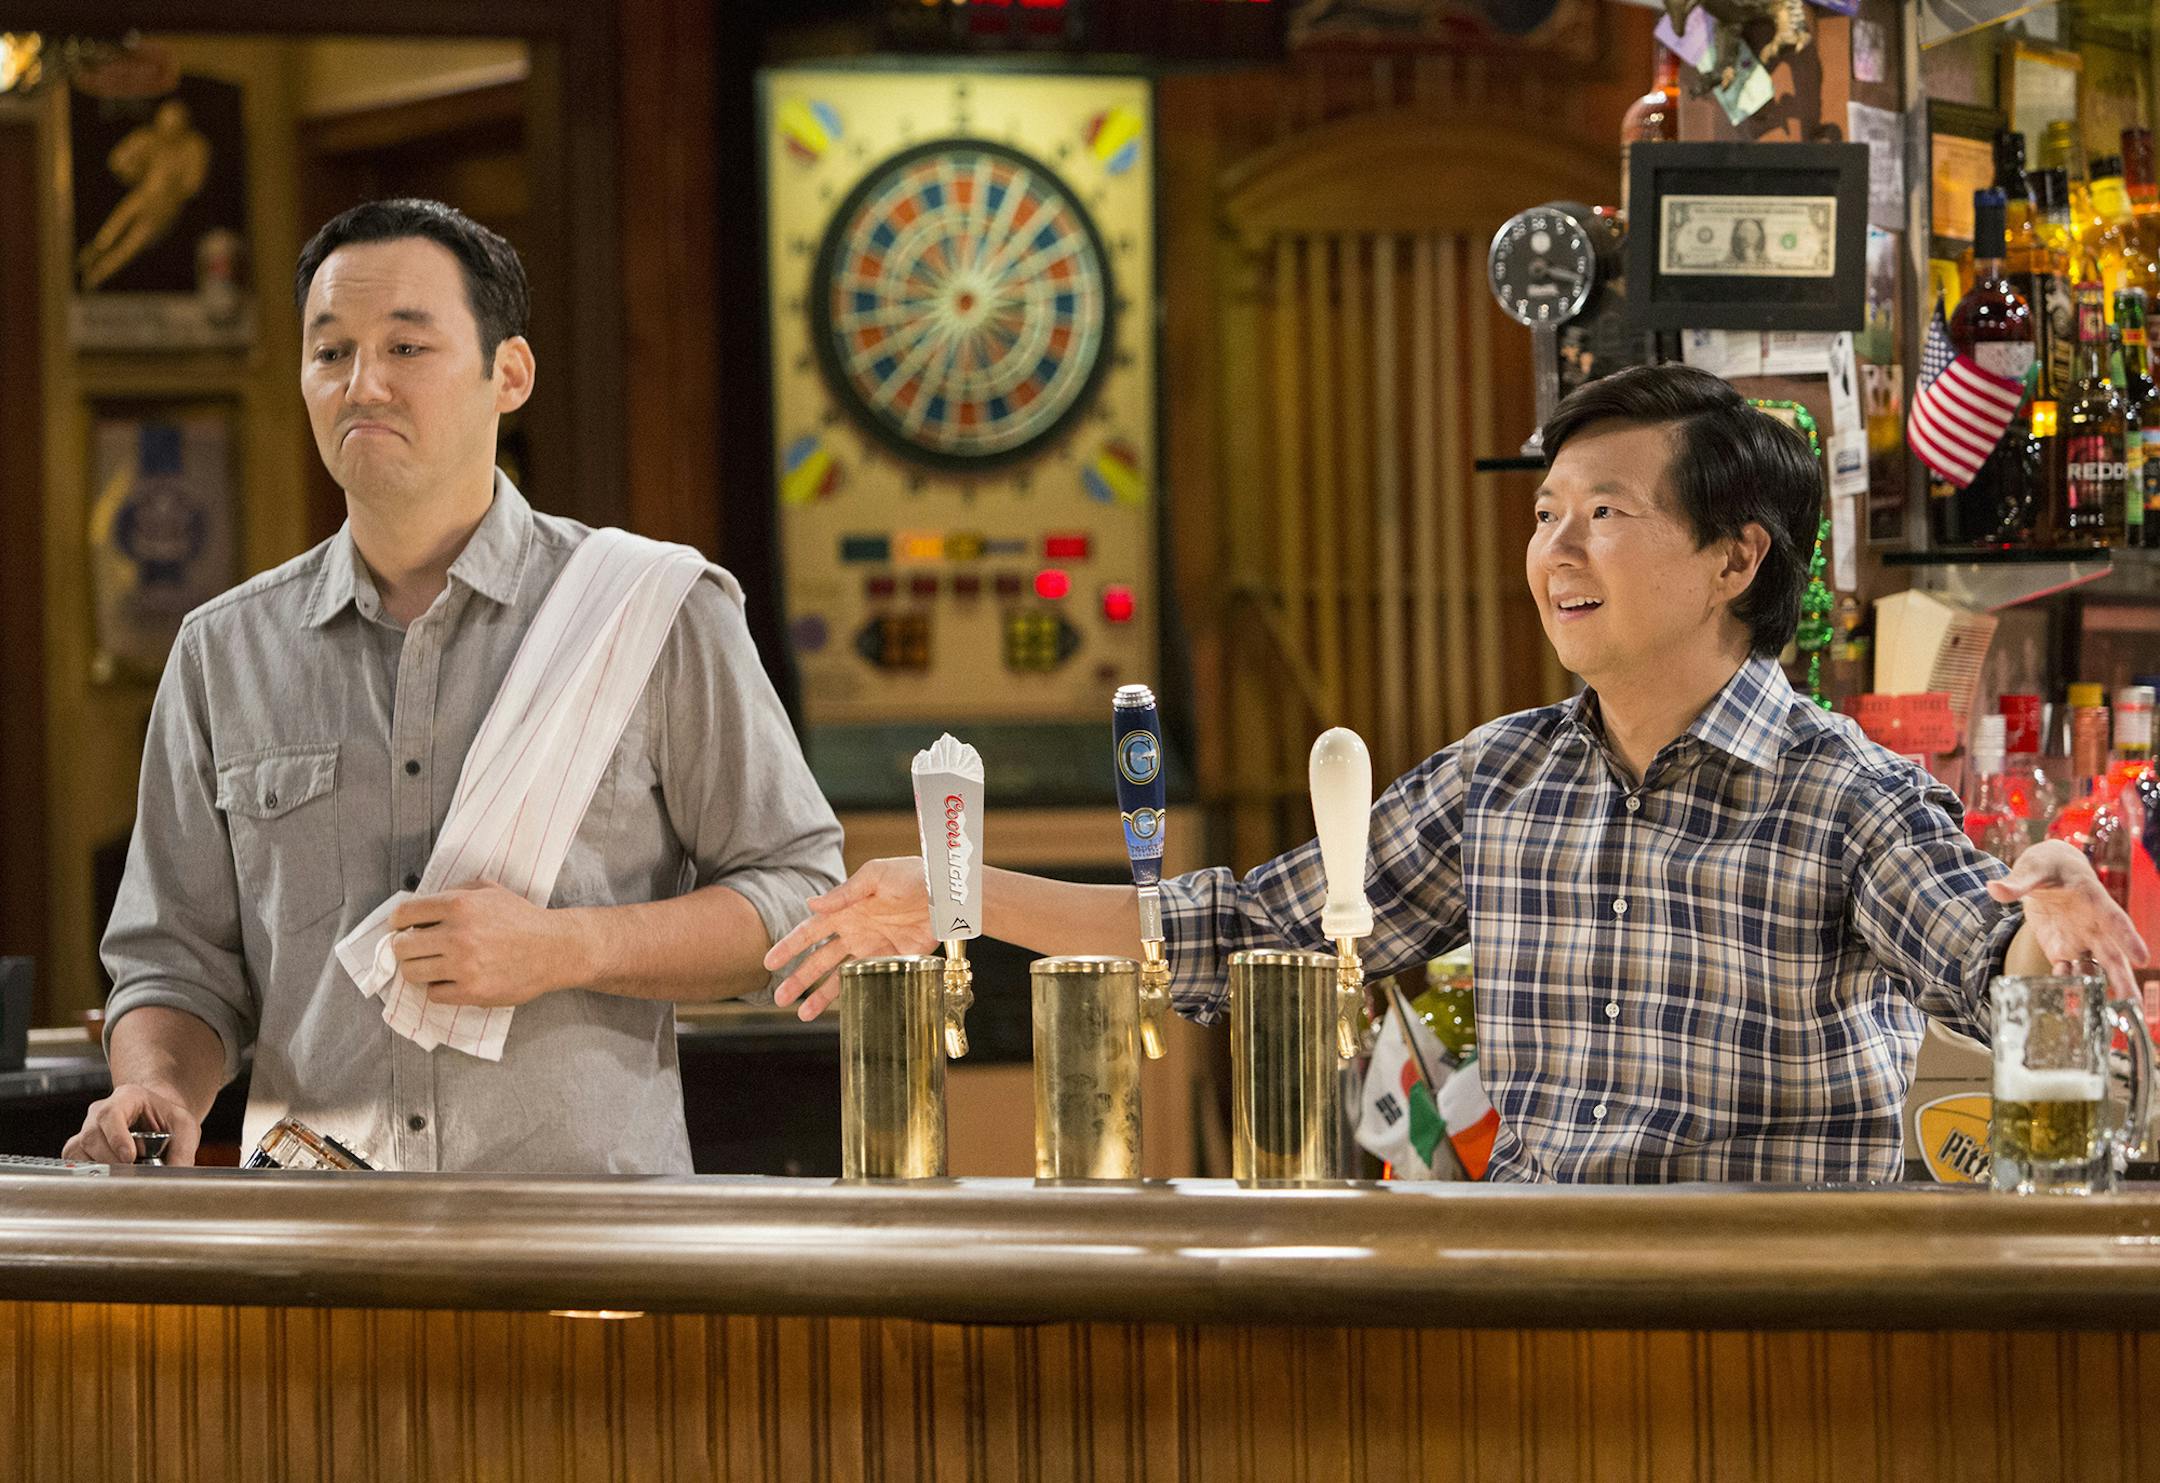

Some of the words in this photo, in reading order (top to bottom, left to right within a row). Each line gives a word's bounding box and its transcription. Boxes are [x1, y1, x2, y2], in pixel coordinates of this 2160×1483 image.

[1126, 739, 1154, 775] G
[943, 793, 965, 849] Coors
[947, 848, 965, 906] LIGHT
[1937, 1128, 1993, 1178] Pitt
